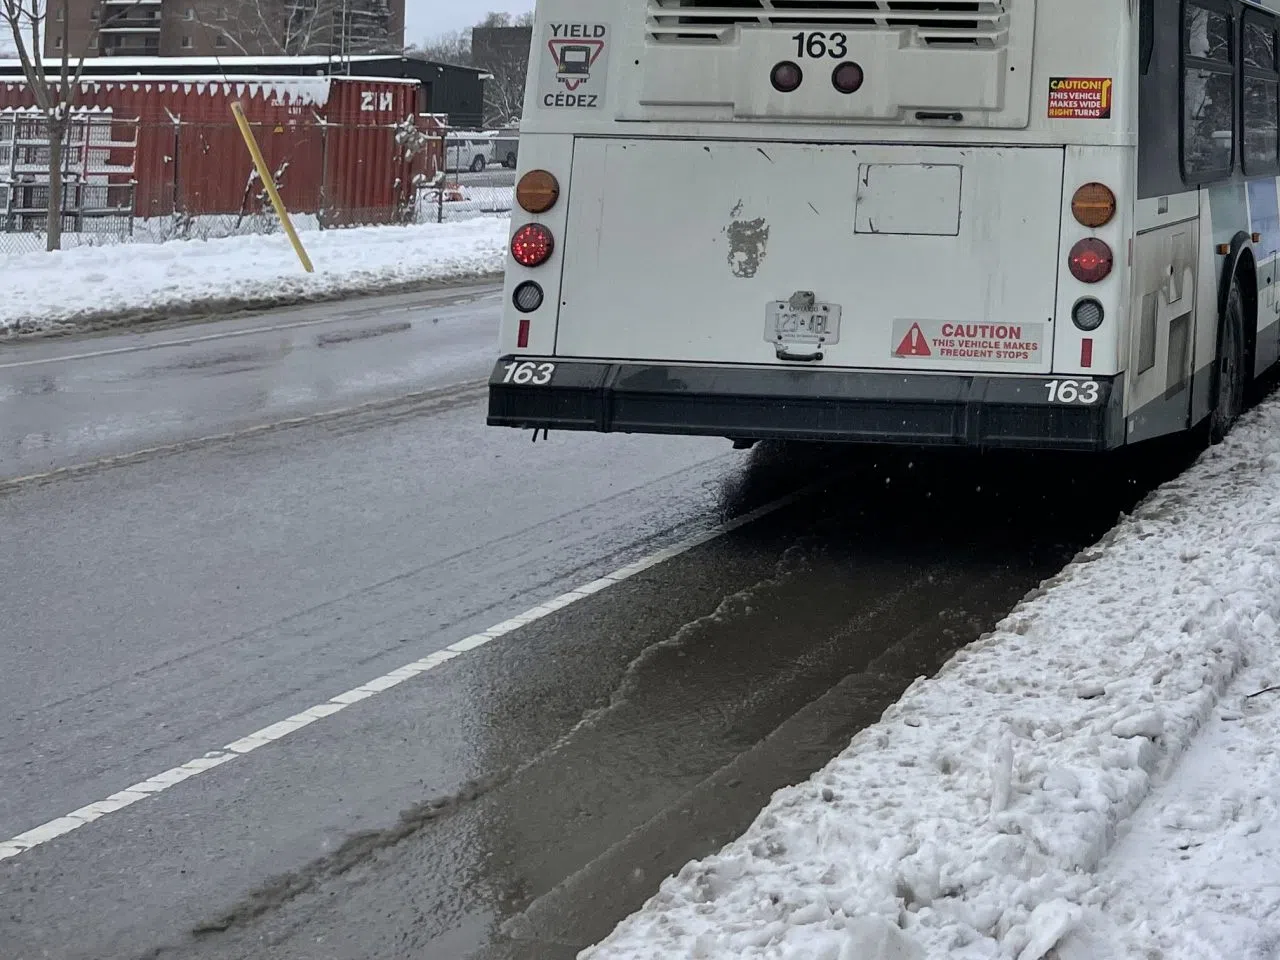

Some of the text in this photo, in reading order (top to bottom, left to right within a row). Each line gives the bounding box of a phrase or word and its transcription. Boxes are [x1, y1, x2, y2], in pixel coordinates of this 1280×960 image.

[550, 24, 606, 38] YIELD
[792, 32, 847, 58] 163
[1050, 80, 1101, 90] CAUTION!
[543, 90, 598, 107] CÉDEZ
[1050, 92, 1101, 100] THIS VEHICLE
[1080, 100, 1101, 108] WIDE
[1049, 108, 1073, 116] RIGHT
[941, 323, 1021, 340] CAUTION
[932, 338, 1038, 351] THIS VEHICLE MAKES
[940, 348, 1029, 360] FREQUENT STOPS
[503, 361, 555, 385] 163
[1044, 380, 1099, 403] 163
